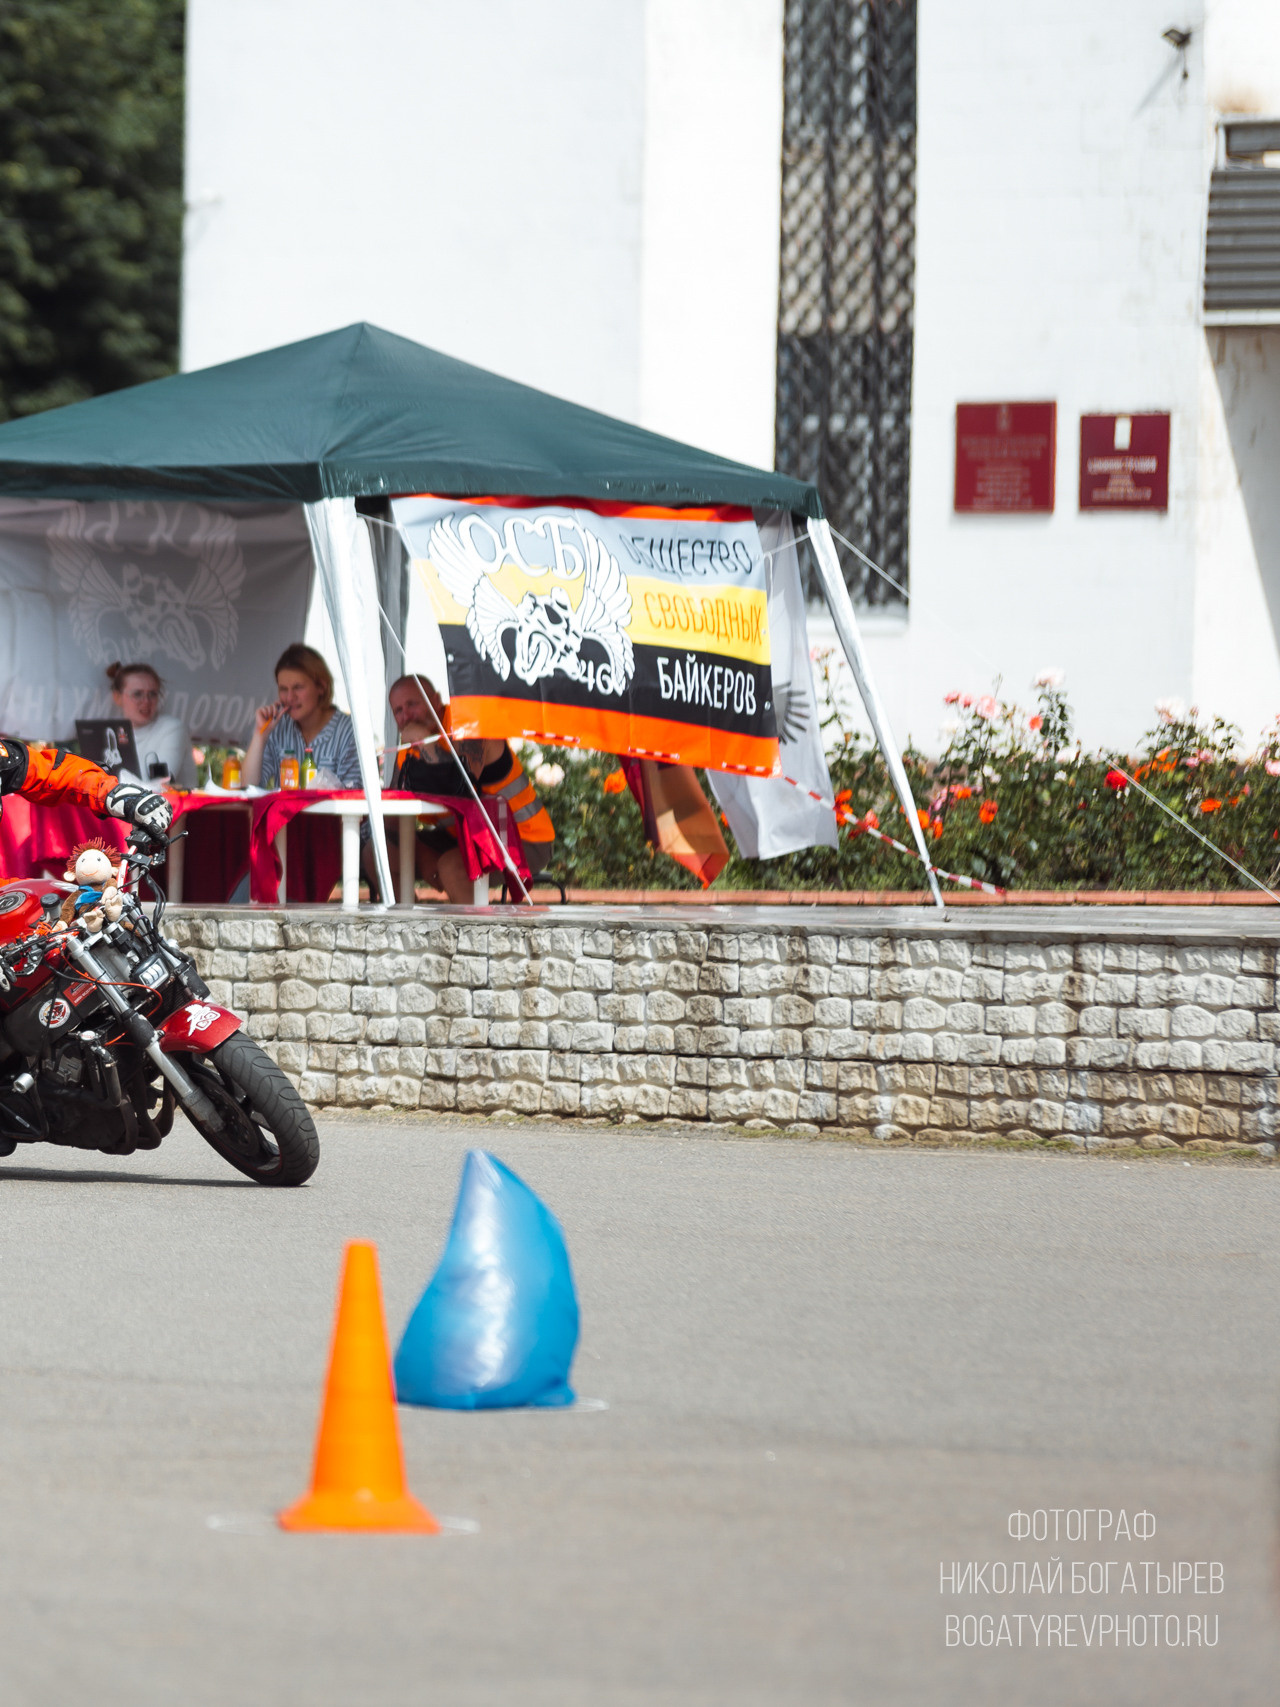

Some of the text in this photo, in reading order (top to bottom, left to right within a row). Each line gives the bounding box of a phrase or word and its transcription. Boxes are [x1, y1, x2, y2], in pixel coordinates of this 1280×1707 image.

[458, 512, 585, 581] ОСБ
[619, 534, 753, 582] ОБЩЕСТВО
[643, 591, 762, 646] СВОБОДНЫХ
[656, 652, 757, 716] БАЙКЕРОВ
